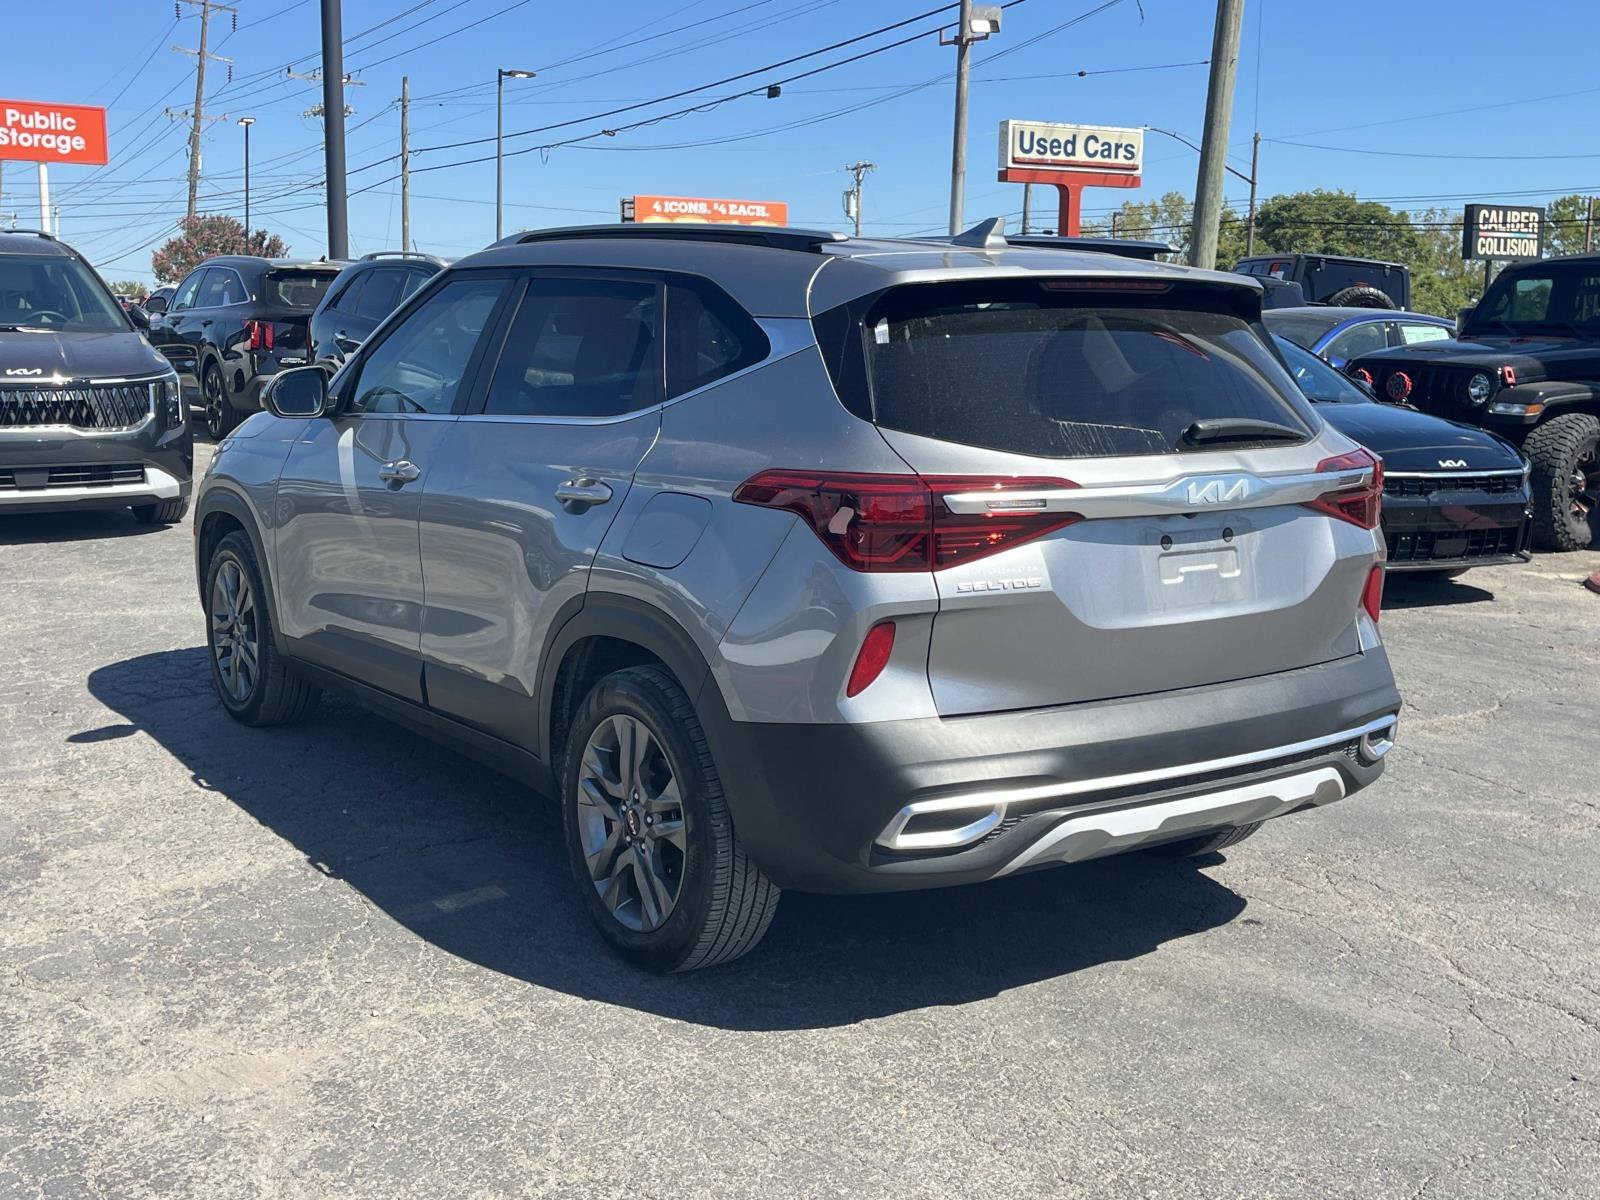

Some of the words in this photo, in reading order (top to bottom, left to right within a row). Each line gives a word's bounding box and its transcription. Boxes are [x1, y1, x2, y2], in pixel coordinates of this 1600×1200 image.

[6, 108, 77, 131] Public
[0, 127, 86, 154] Storage
[1019, 130, 1077, 157] Used
[1084, 134, 1136, 160] Cars
[652, 201, 661, 212] 4
[664, 201, 711, 214] ICONS.
[729, 204, 770, 217] EACH.
[1479, 209, 1539, 233] CALIBER
[1477, 237, 1538, 257] COLLISION
[956, 577, 1041, 593] SELTOS
